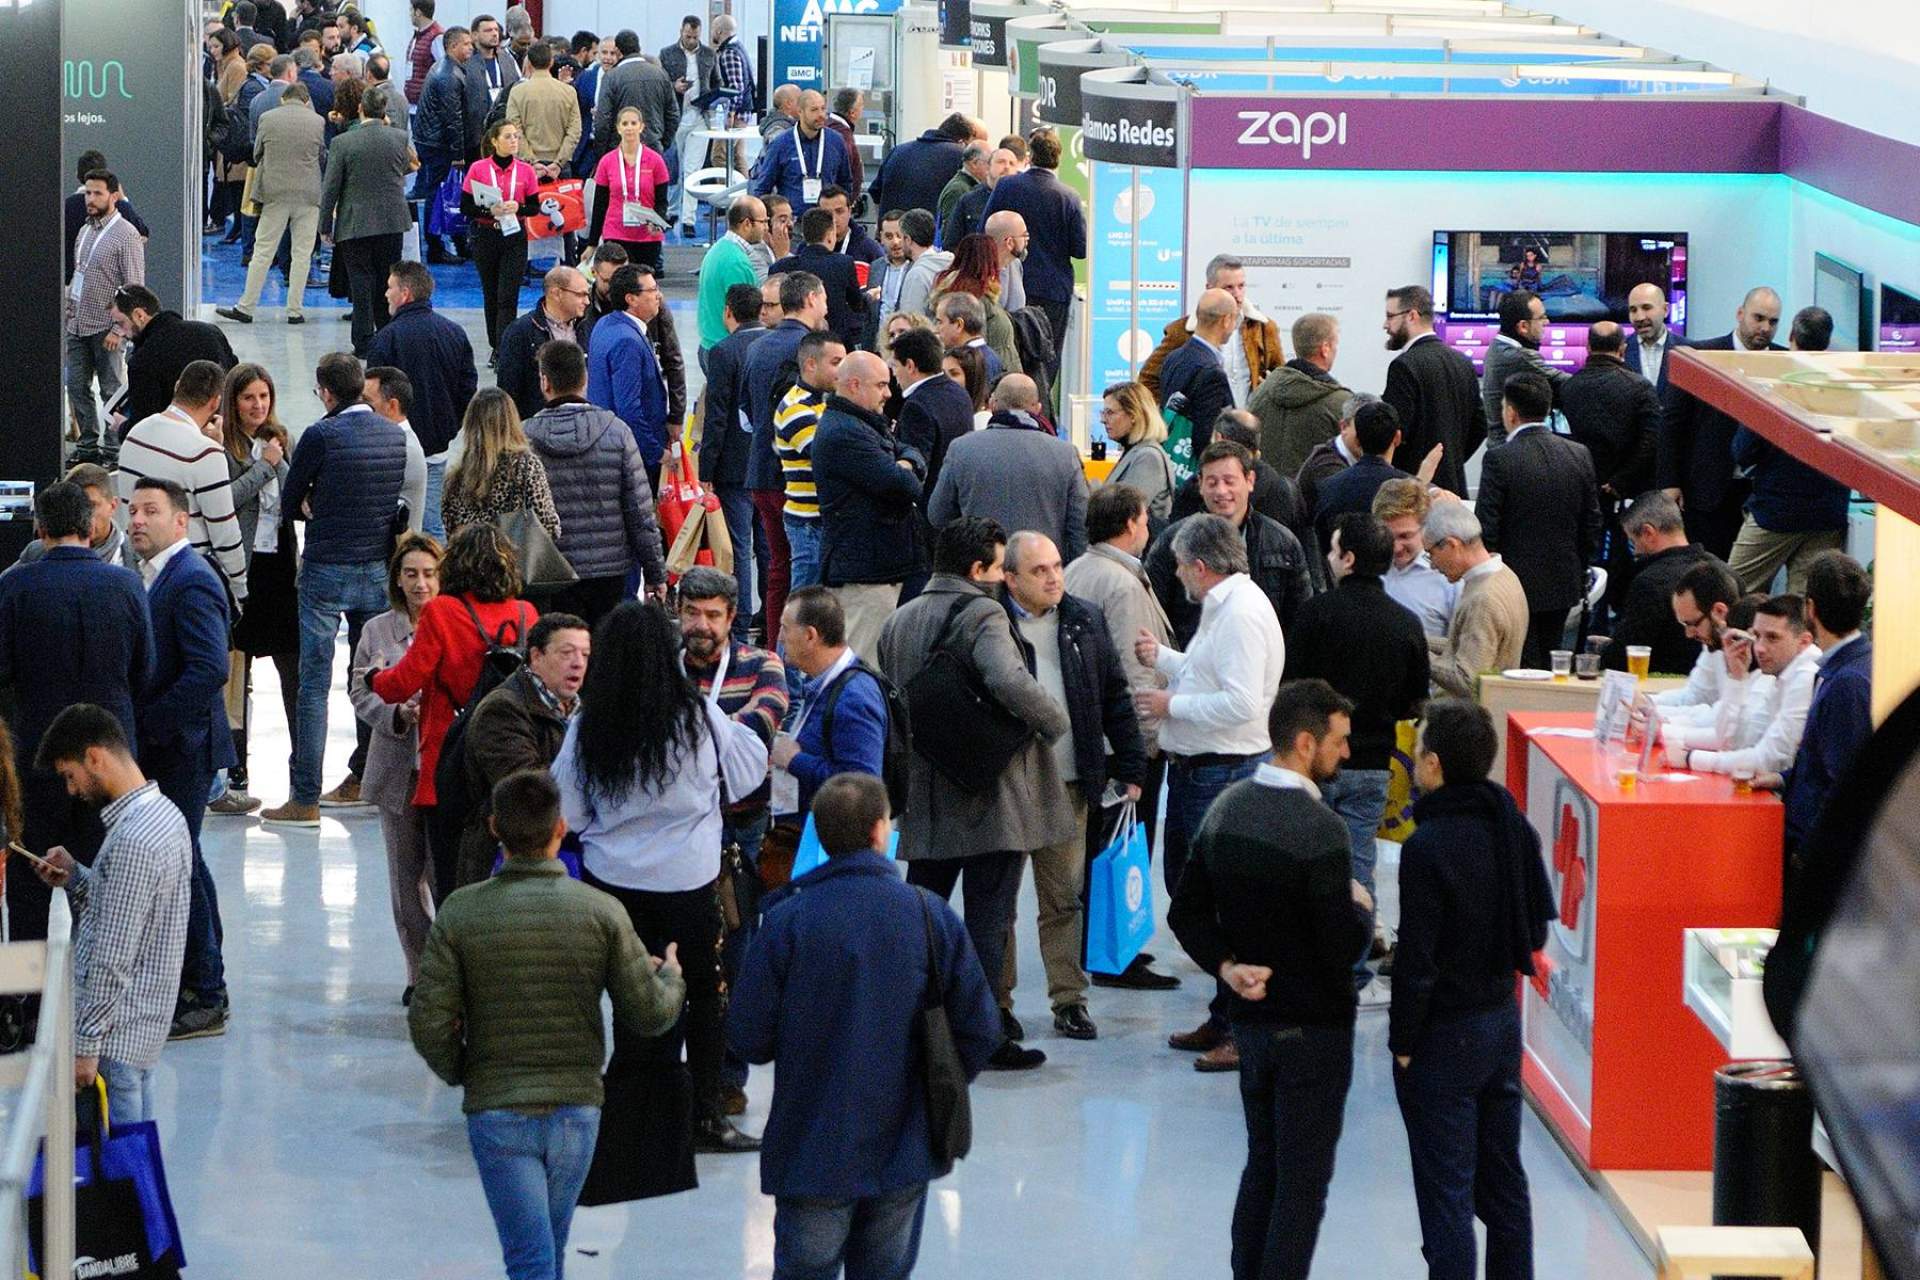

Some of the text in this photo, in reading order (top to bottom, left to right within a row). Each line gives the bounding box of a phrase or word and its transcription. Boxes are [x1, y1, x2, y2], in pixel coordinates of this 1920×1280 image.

[781, 25, 823, 42] NET
[1119, 118, 1174, 147] Redes
[1238, 111, 1347, 159] zapi
[1252, 216, 1271, 228] TV
[1244, 232, 1257, 244] la
[1242, 257, 1292, 267] ATAFORMAS
